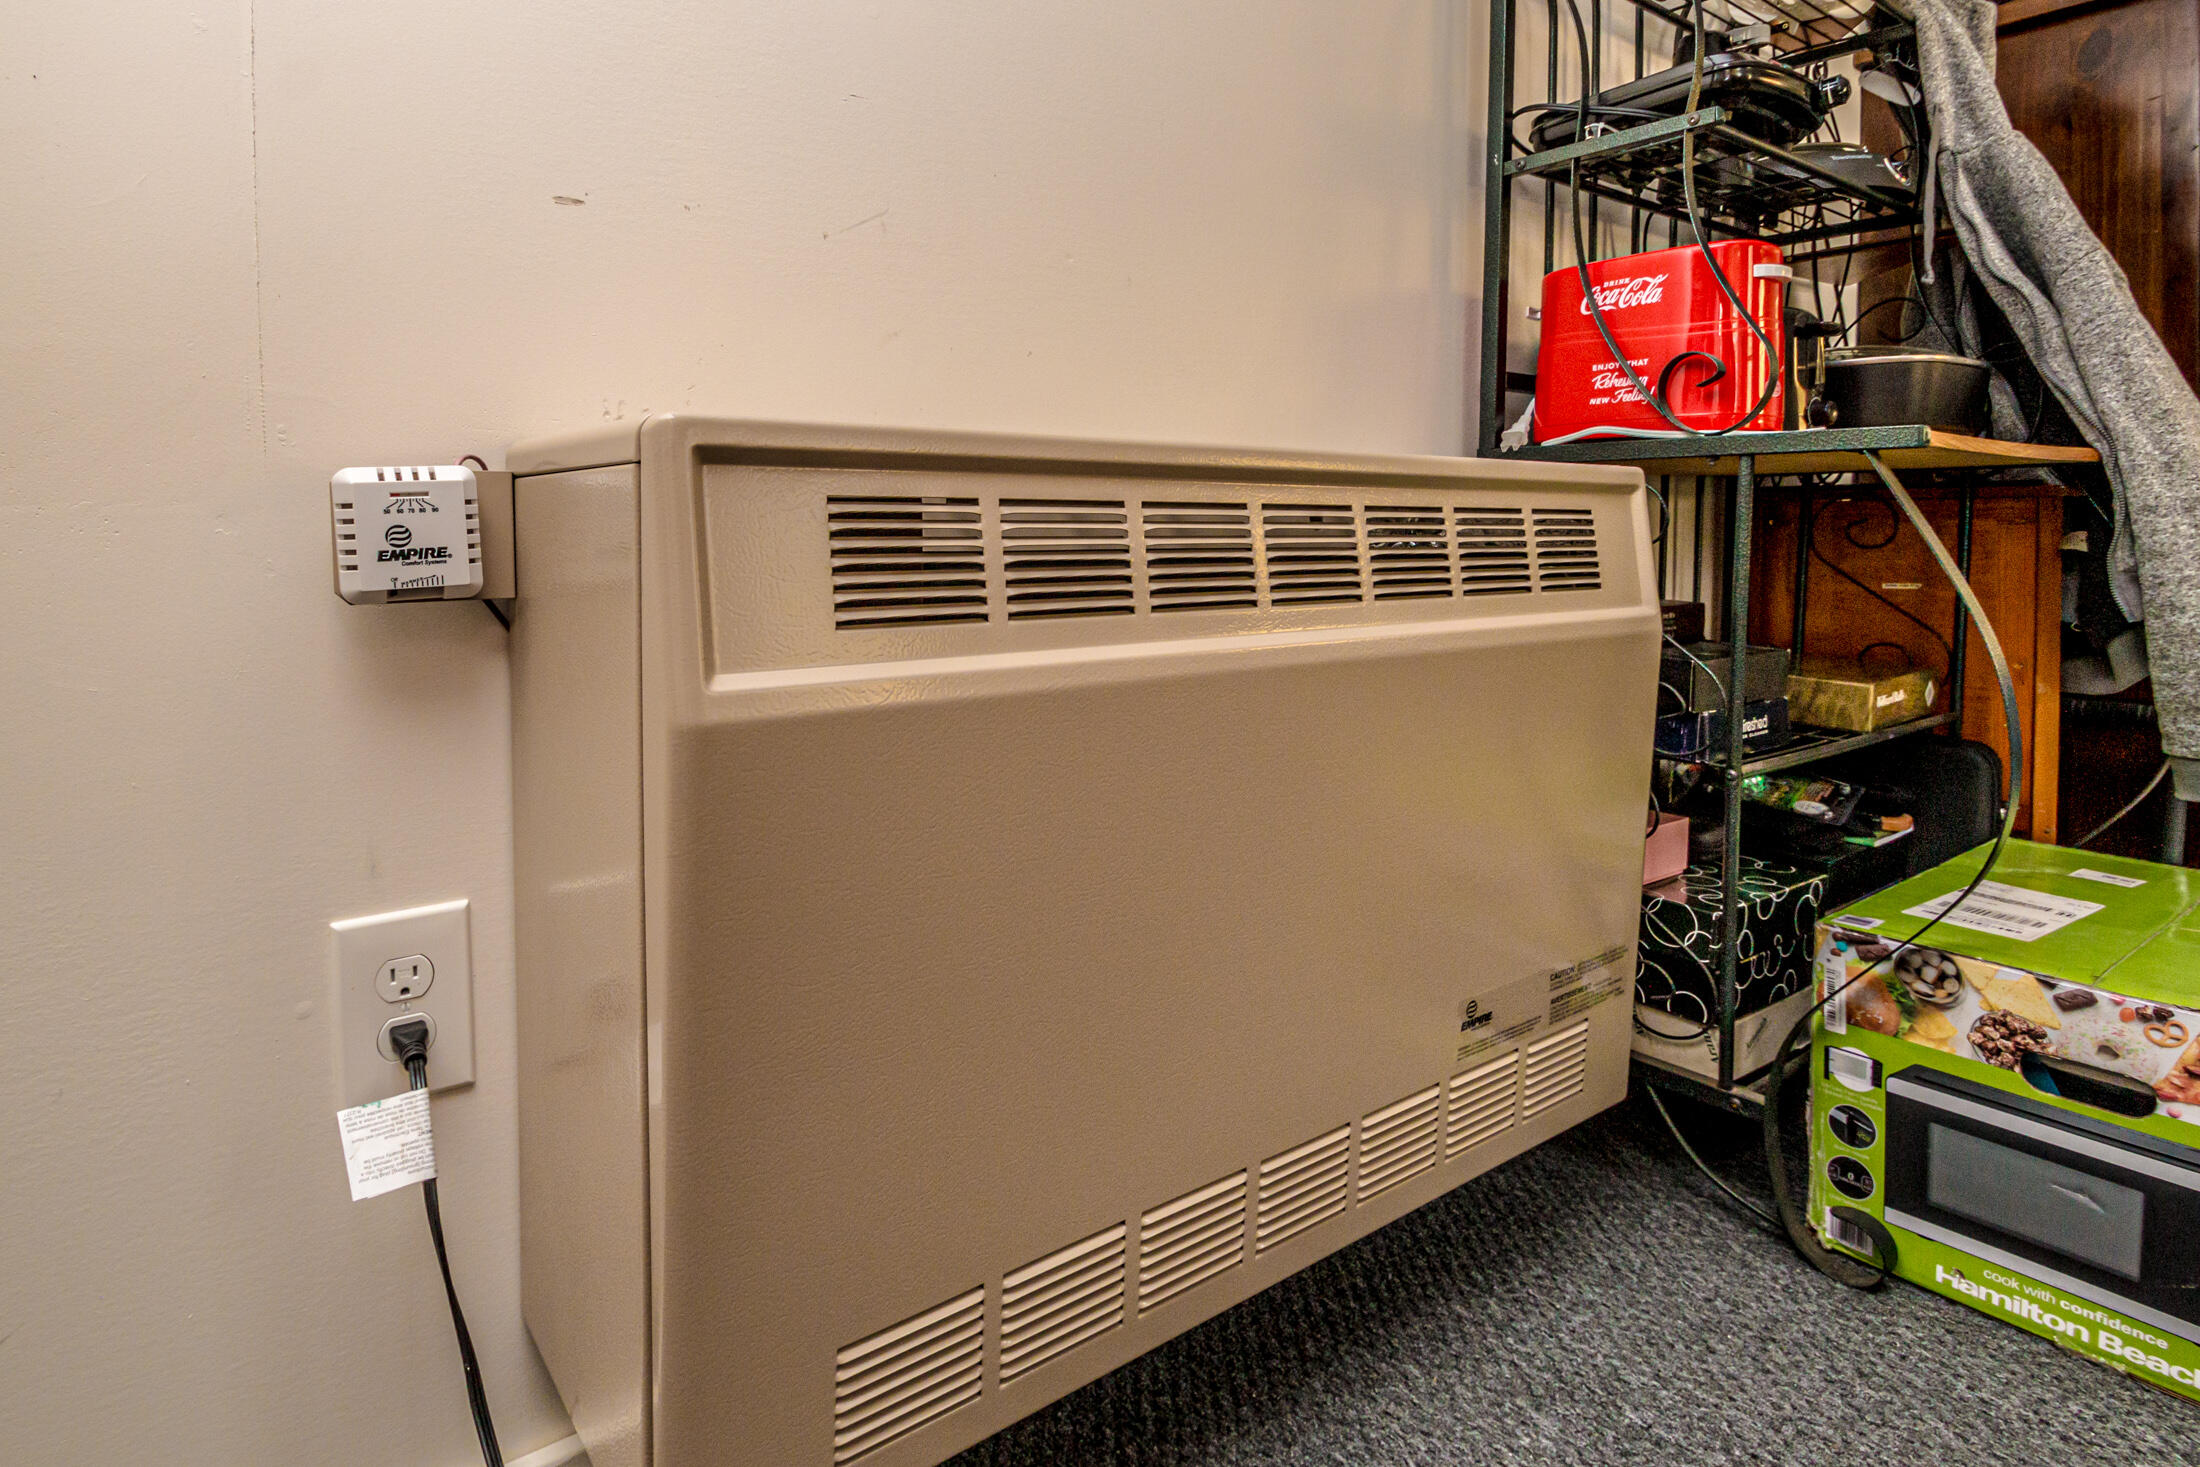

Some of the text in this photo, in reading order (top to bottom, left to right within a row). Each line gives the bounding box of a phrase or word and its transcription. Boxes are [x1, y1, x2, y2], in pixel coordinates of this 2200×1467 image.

[1603, 277, 1631, 288] DRINK
[1580, 273, 1669, 315] Coca-Cola
[1592, 362, 1620, 371] ENJOY
[1589, 397, 1610, 405] NEW
[1461, 1010, 1493, 1032] EMPIRE
[1935, 1264, 2090, 1343] Hamilton
[1983, 1269, 2169, 1350] cook with confidence
